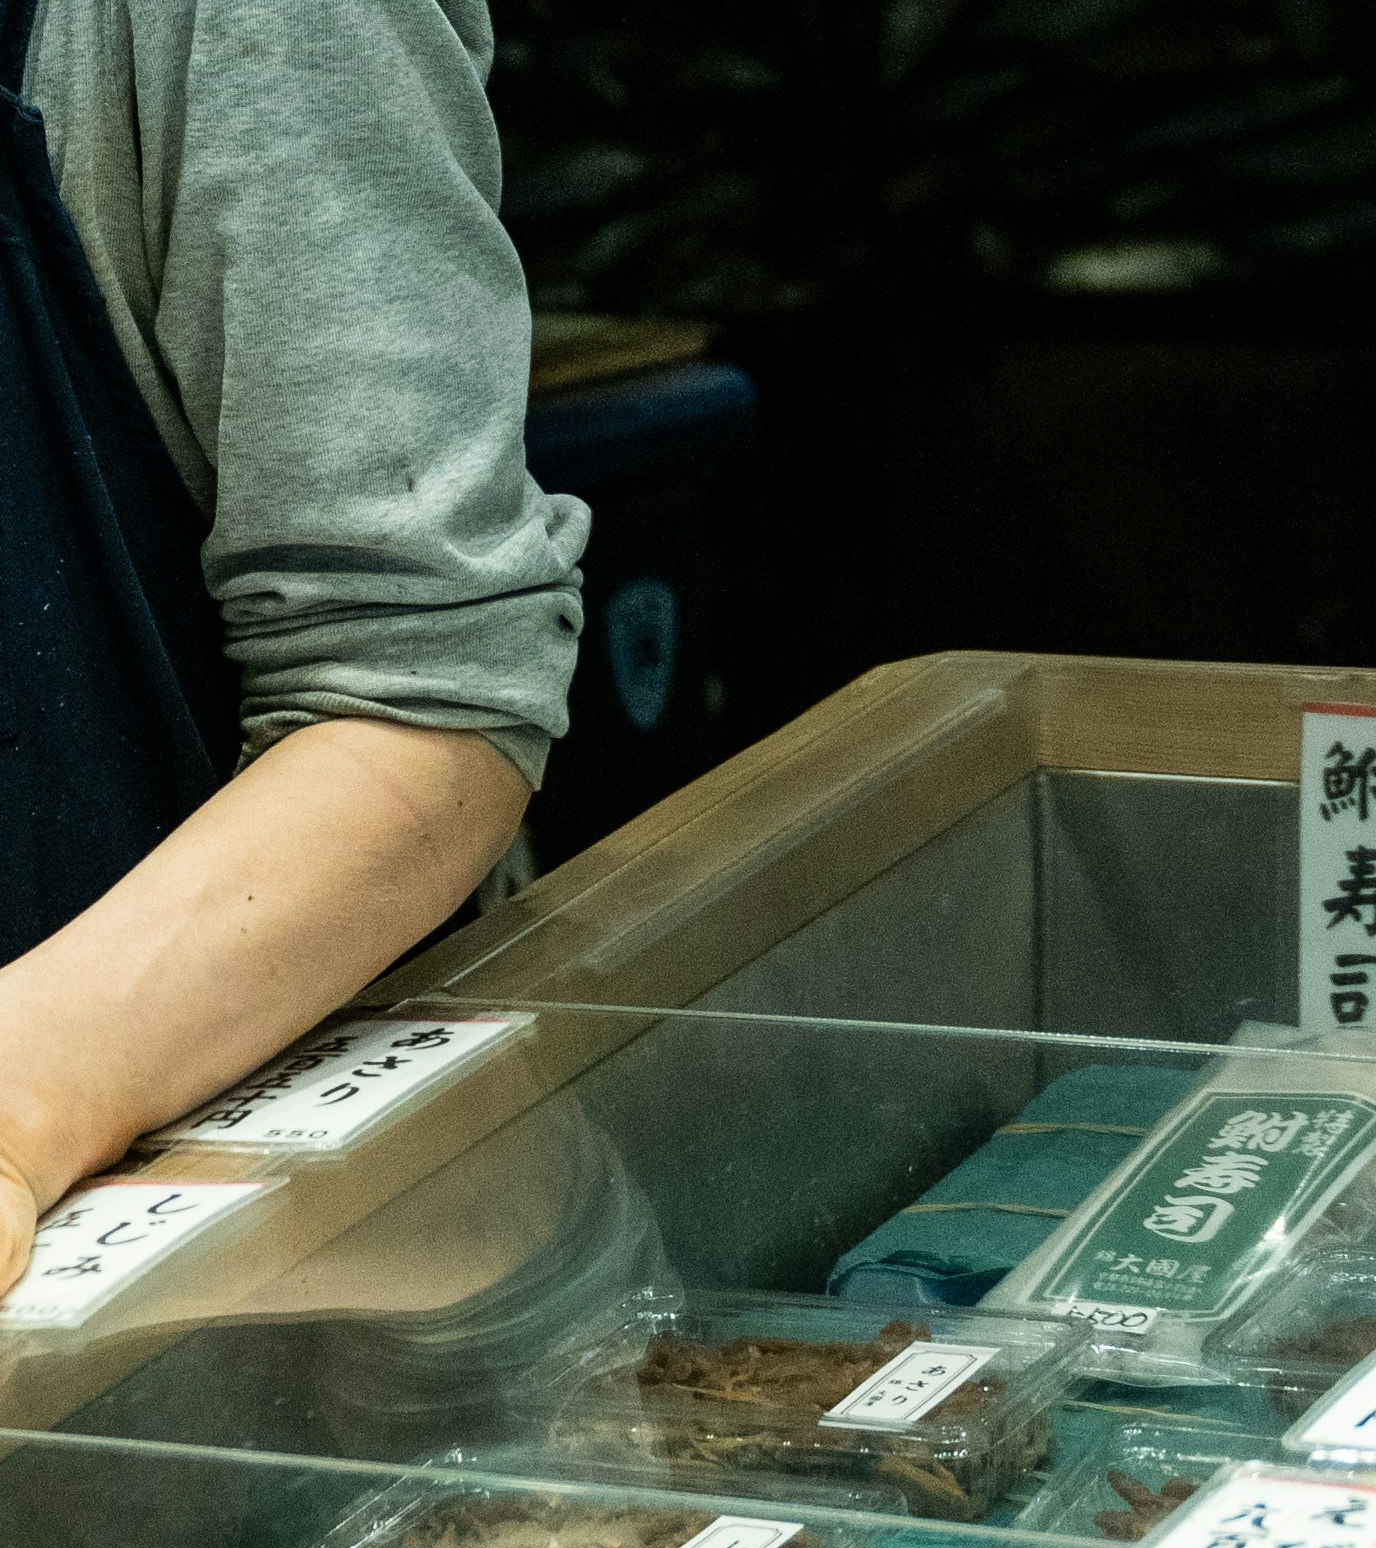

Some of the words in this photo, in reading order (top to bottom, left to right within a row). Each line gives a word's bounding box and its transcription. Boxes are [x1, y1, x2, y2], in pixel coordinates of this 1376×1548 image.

[318, 1026, 454, 1107] あさり
[263, 1129, 328, 1140] 550
[42, 1193, 198, 1280] しじみ
[891, 1365, 947, 1405] あさり
